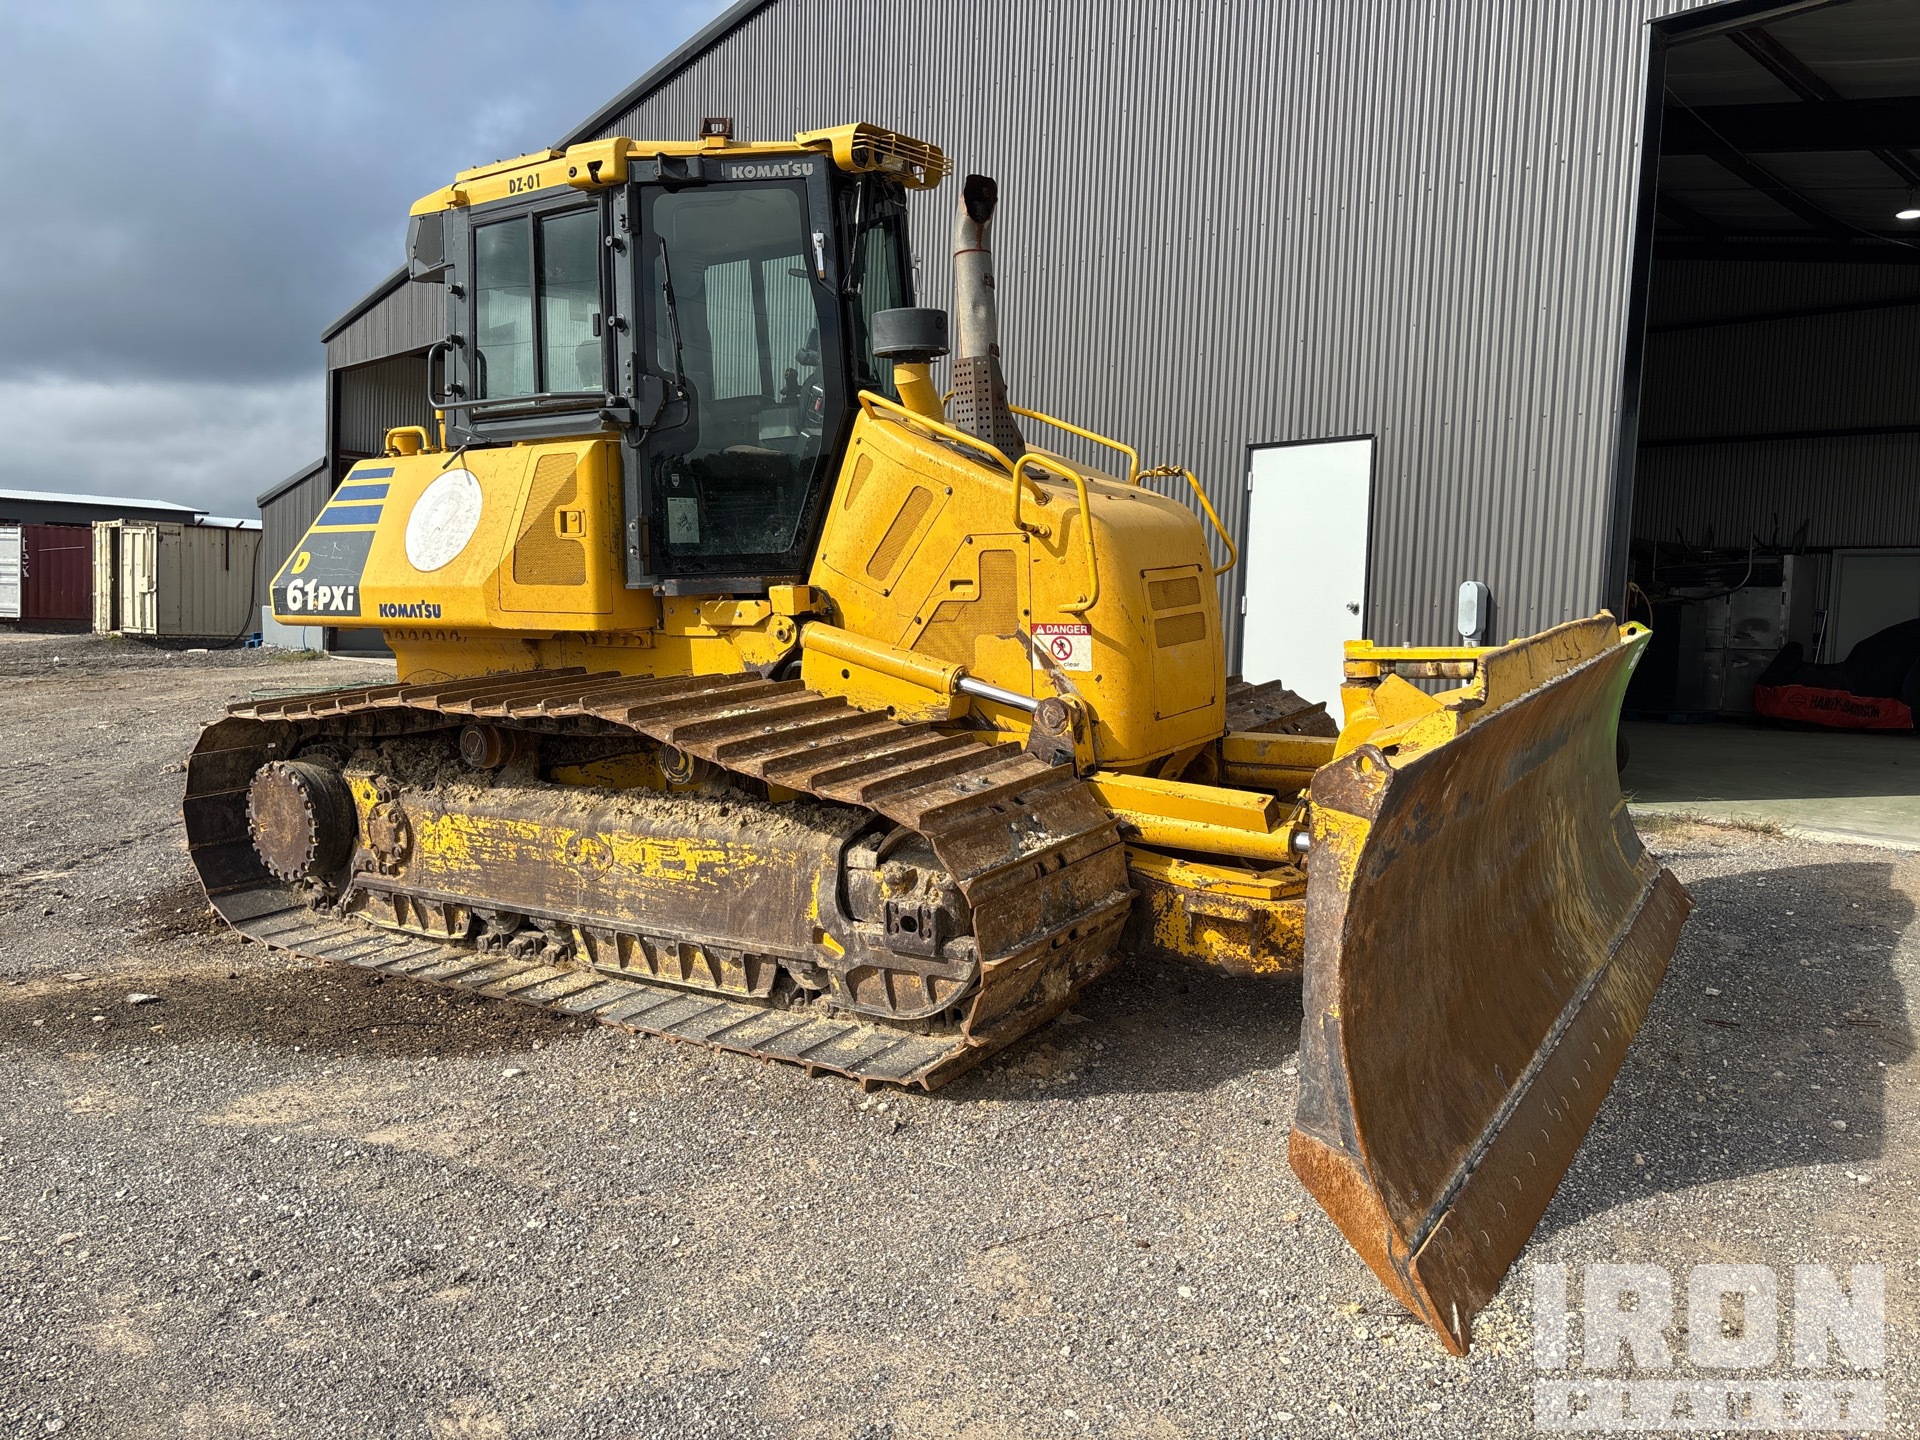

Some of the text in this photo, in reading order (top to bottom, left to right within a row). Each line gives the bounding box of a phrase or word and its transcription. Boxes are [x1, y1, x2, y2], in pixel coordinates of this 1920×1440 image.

[731, 161, 814, 179] KOMATSU
[509, 173, 540, 194] DZ-01
[290, 551, 311, 575] D
[378, 600, 442, 618] KOMATSU
[1046, 624, 1088, 635] DANGER
